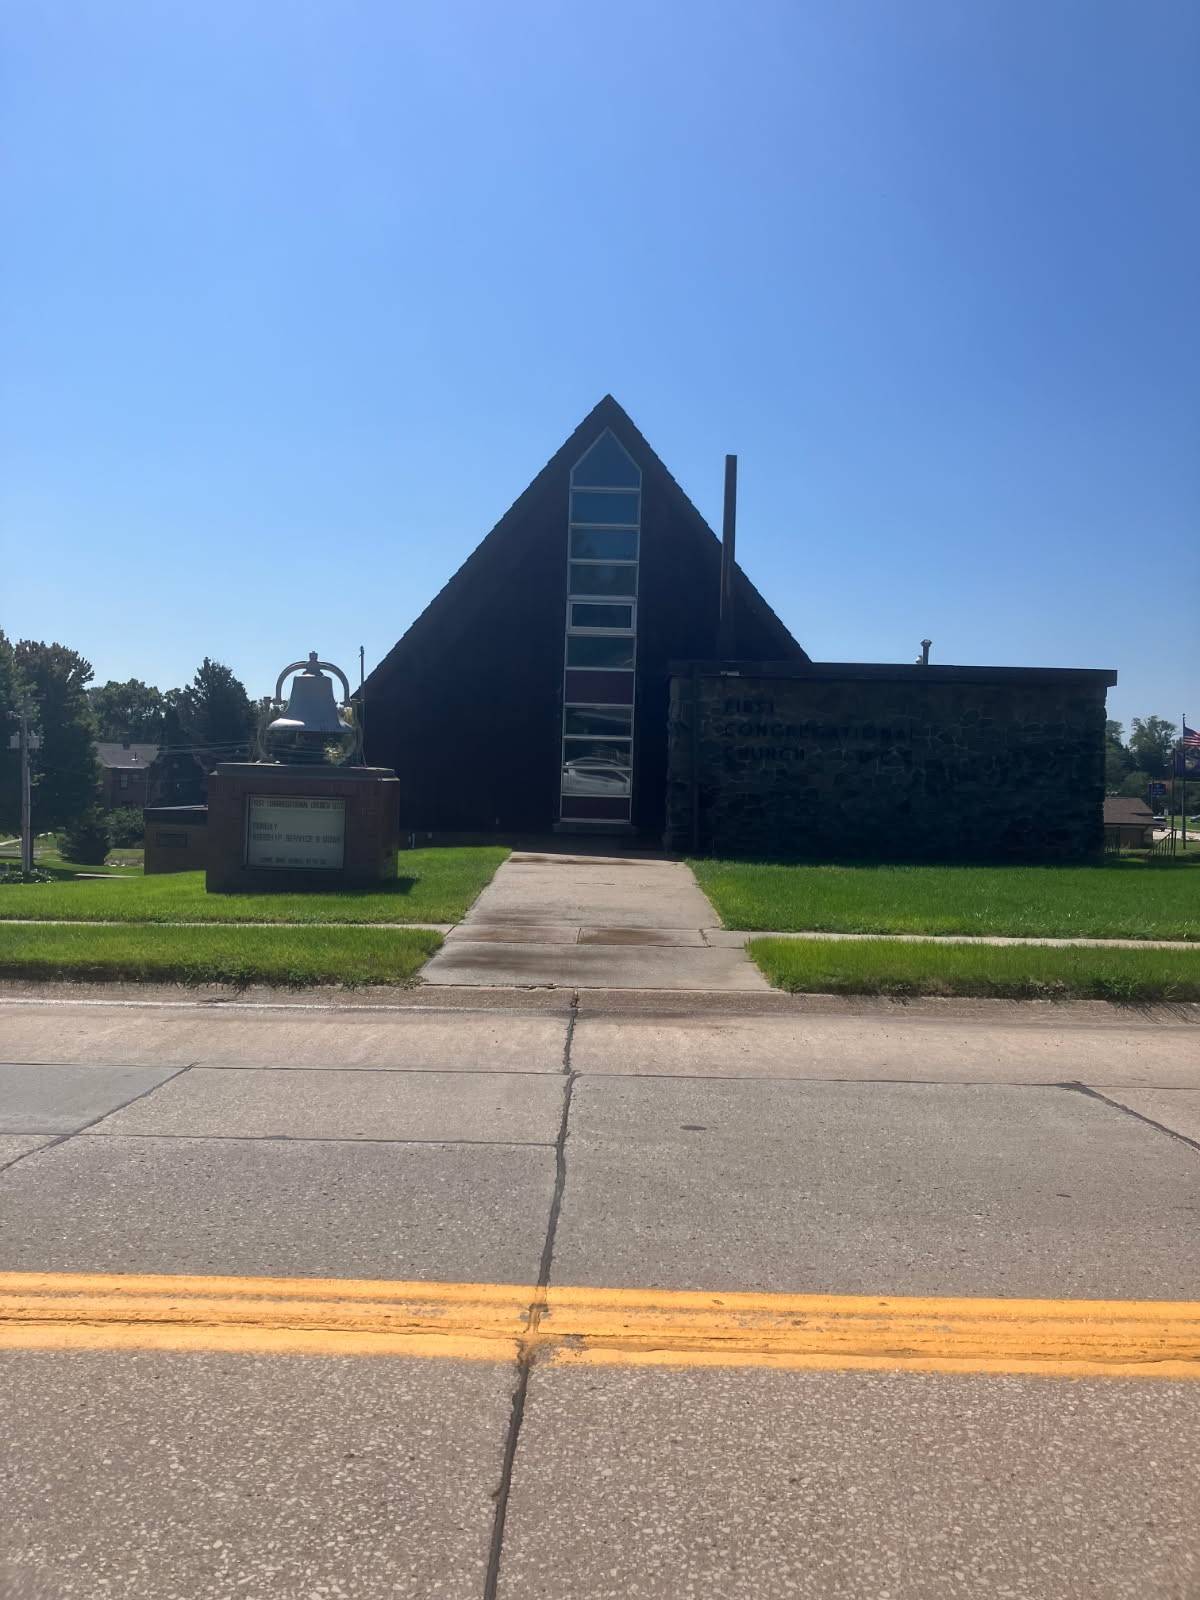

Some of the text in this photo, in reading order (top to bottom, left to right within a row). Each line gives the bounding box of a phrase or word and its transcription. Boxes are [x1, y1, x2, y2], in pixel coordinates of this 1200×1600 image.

[724, 697, 775, 714] FIRST
[721, 720, 913, 739] CONGREGATIONAL
[722, 744, 806, 760] CHURCH
